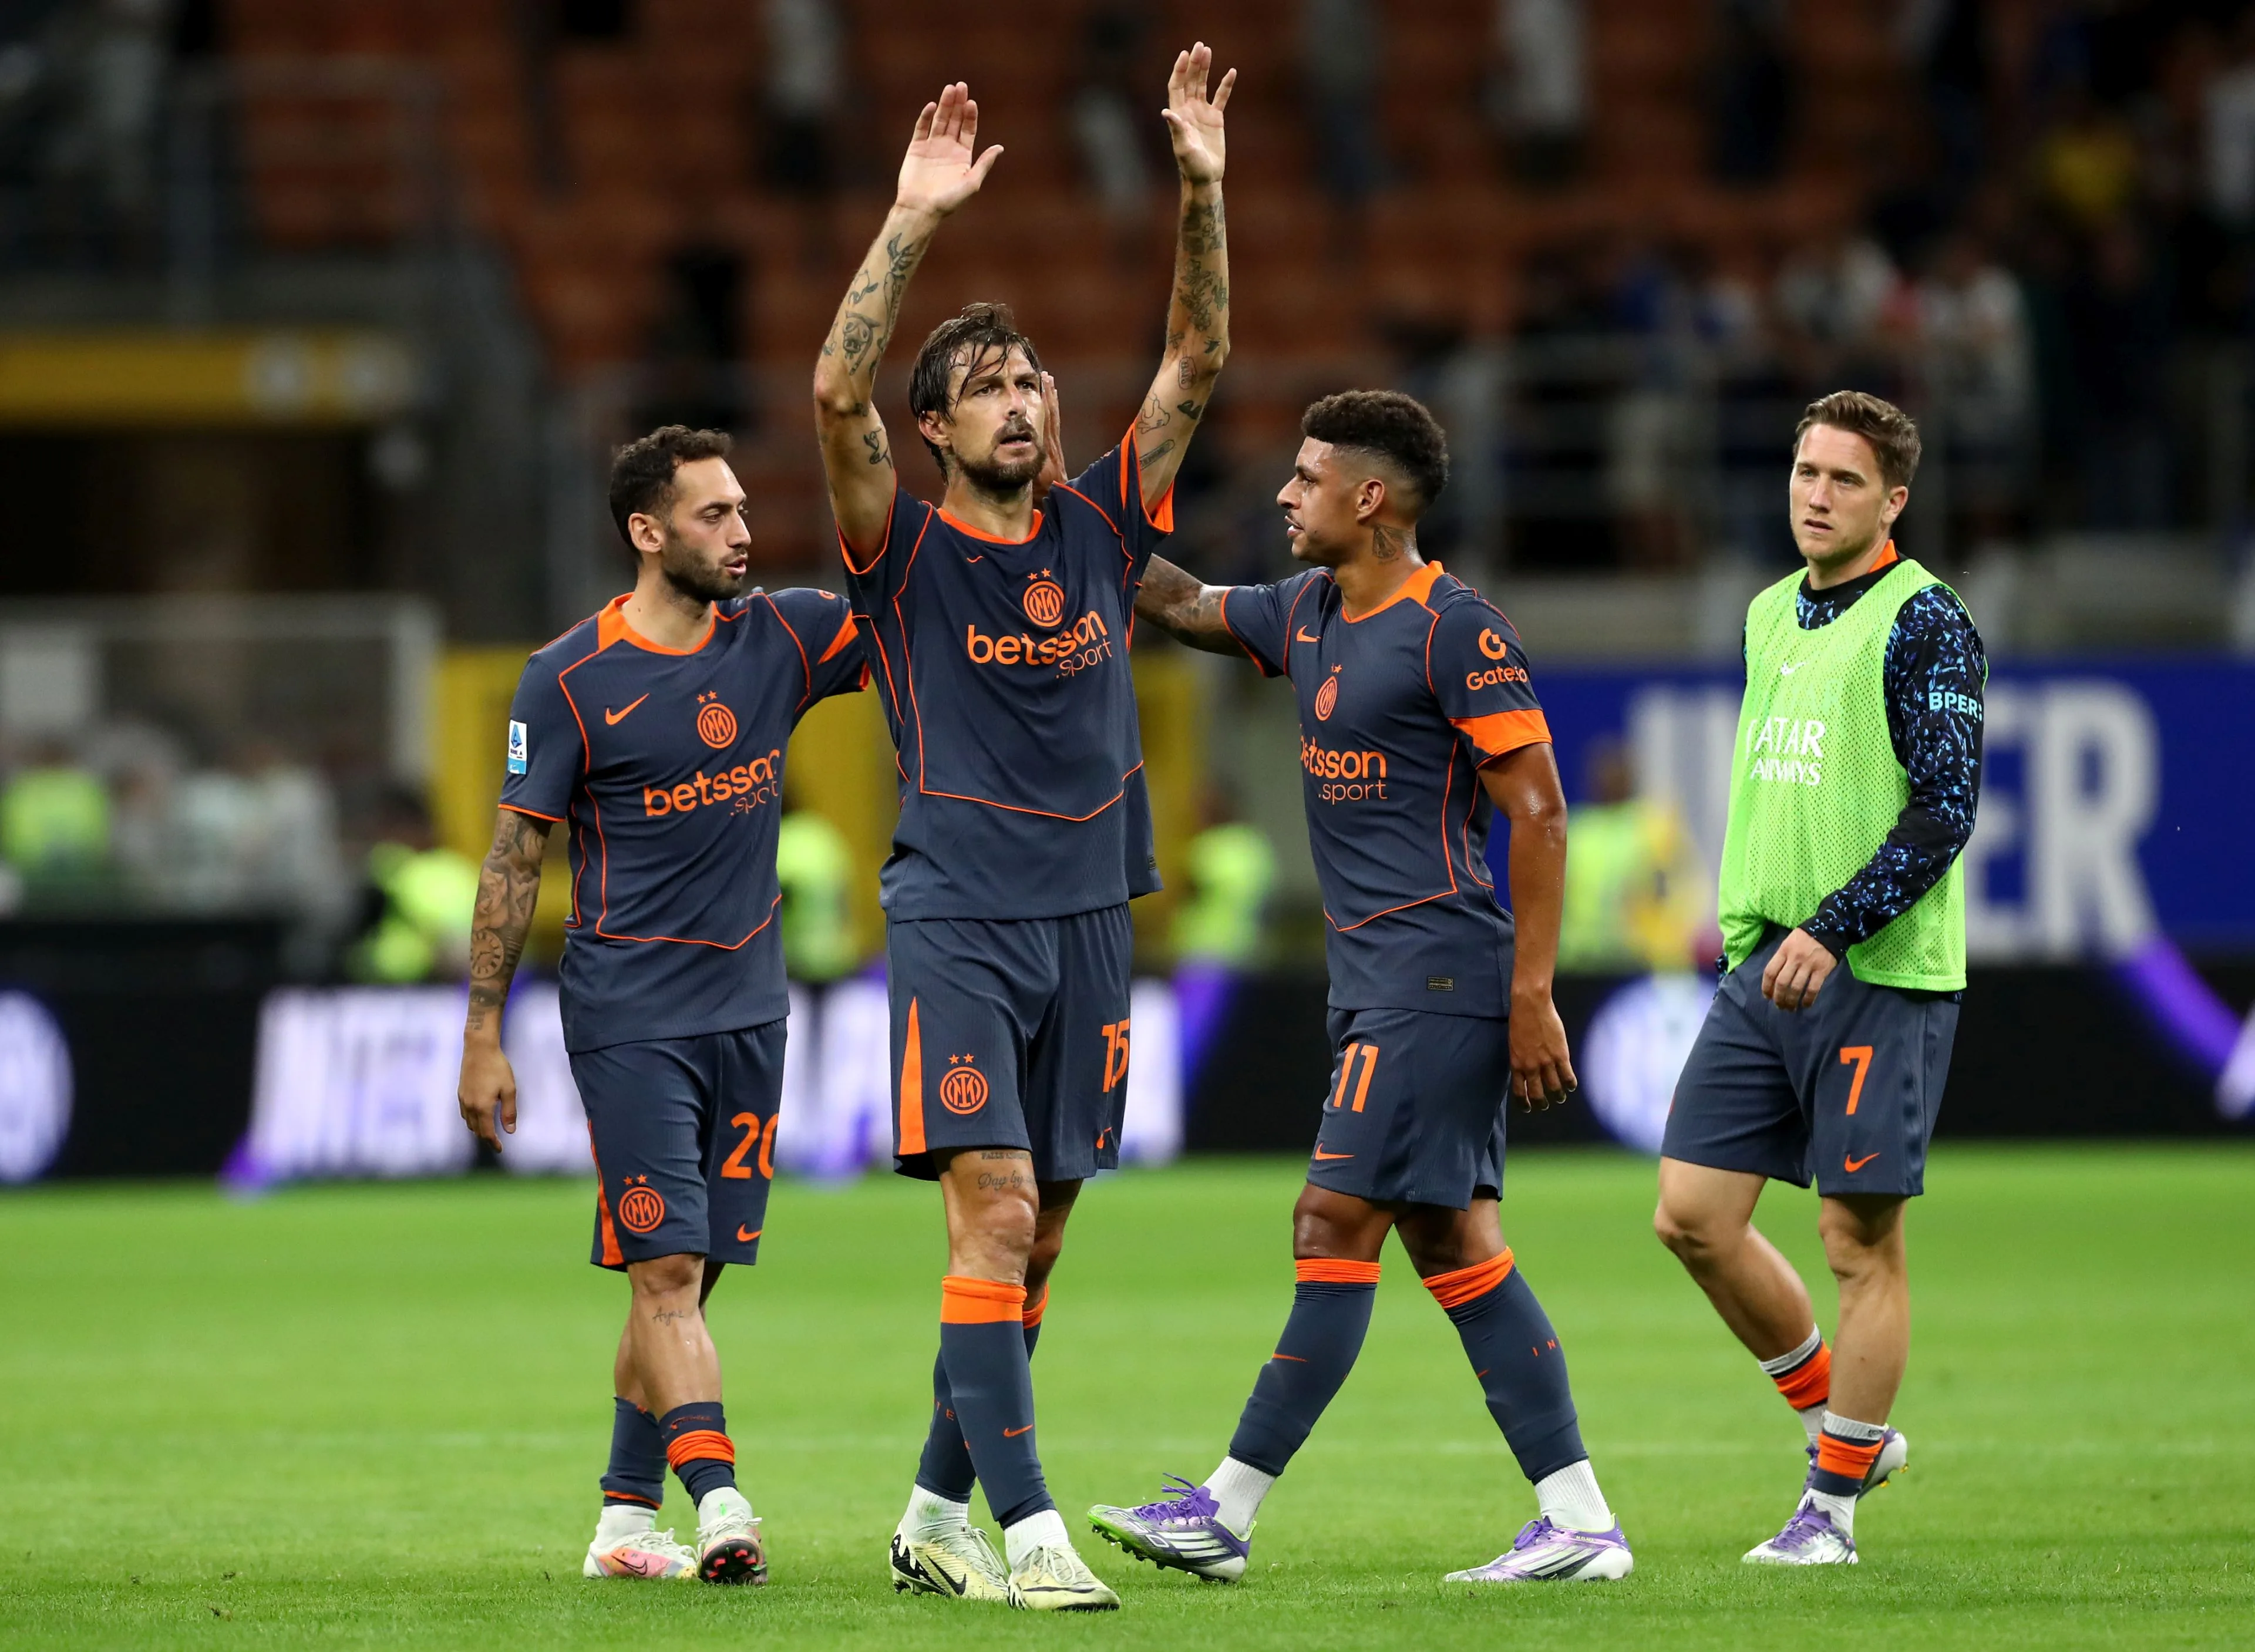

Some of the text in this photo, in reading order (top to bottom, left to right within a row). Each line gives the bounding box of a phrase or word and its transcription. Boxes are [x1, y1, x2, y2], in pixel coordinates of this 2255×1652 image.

[967, 611, 1109, 665] betsson
[1318, 779, 1388, 805] .sport
[1101, 1018, 1130, 1094] 15
[1332, 1042, 1379, 1113] 11
[1839, 1045, 1874, 1115] 7
